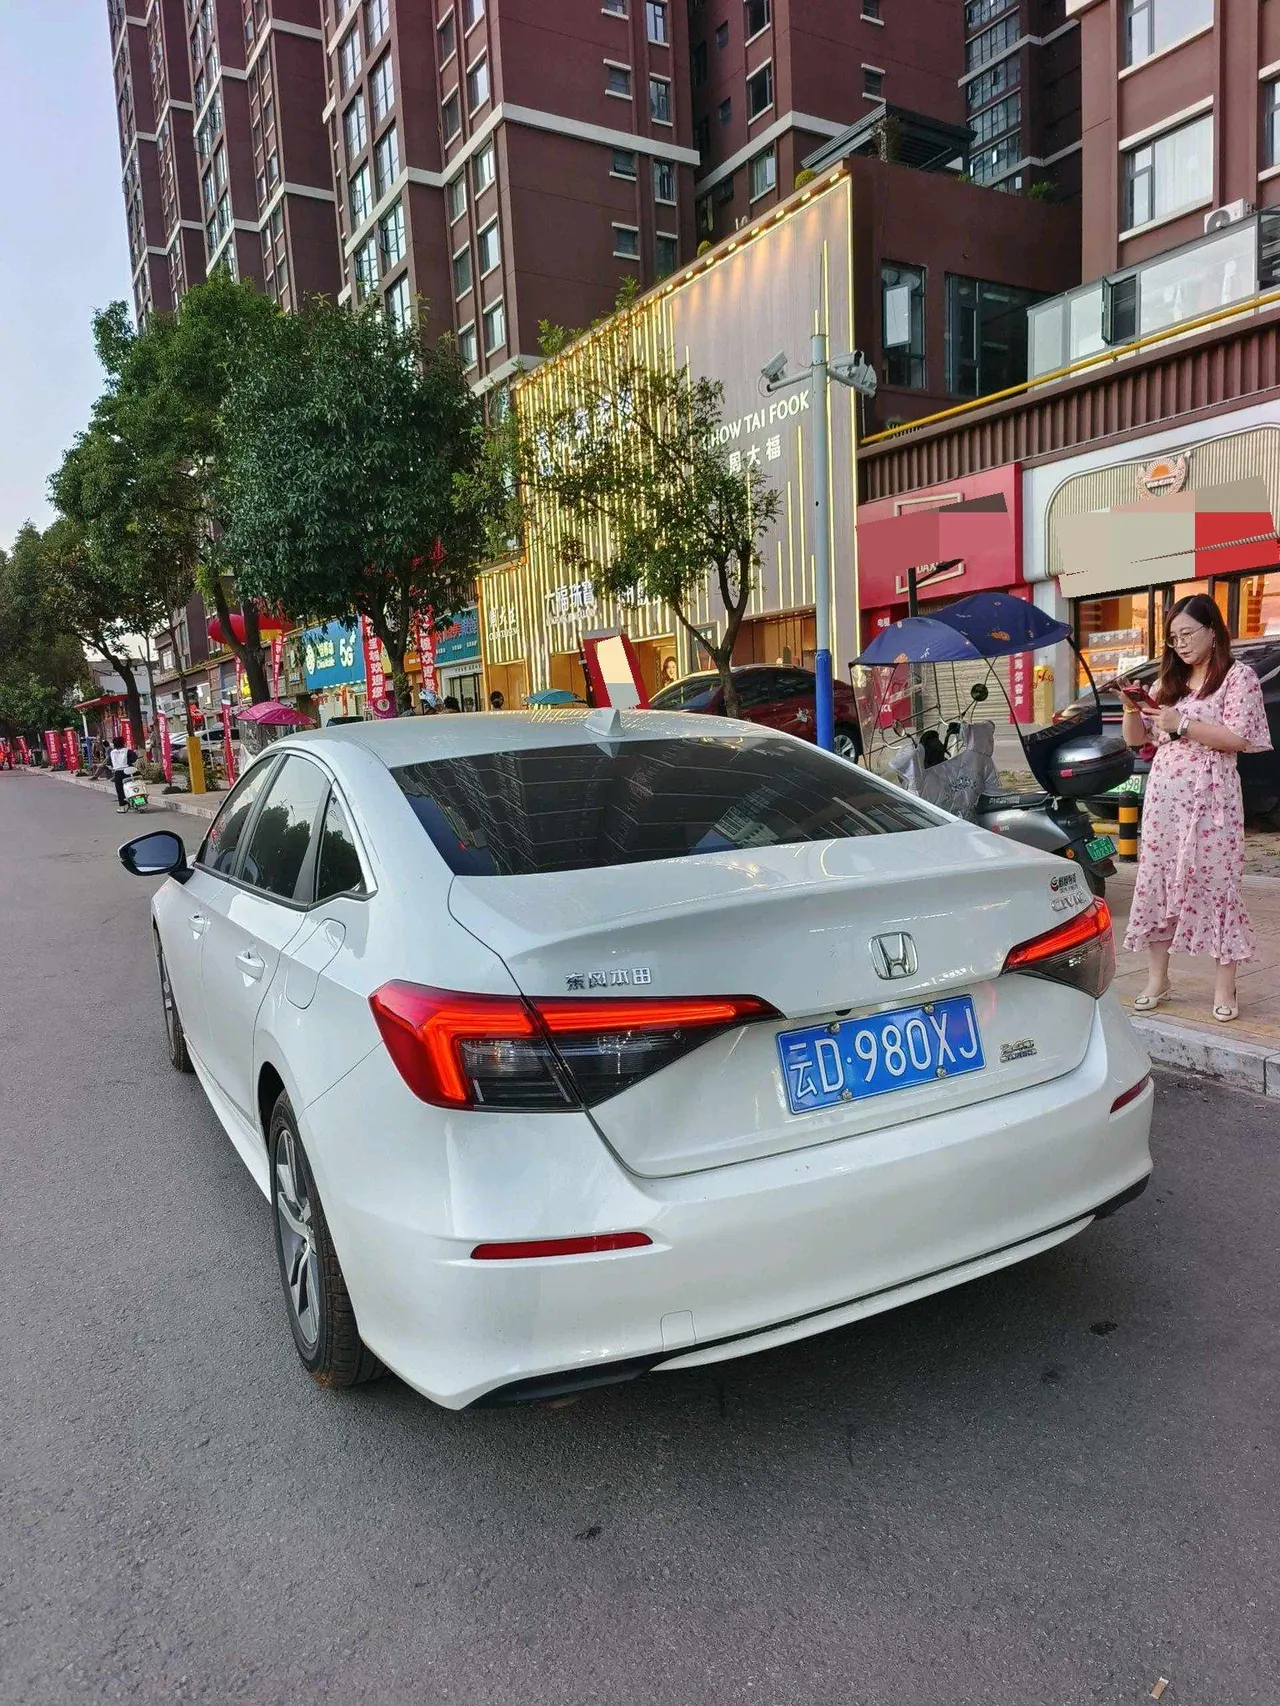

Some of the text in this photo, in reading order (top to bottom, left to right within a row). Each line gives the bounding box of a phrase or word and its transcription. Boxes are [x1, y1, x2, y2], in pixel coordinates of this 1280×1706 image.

[743, 408, 766, 434] TAI
[769, 389, 810, 424] FOOK
[729, 434, 781, 477] 周大福
[339, 637, 354, 668] 5G
[1051, 890, 1087, 912] CIVIC
[565, 967, 652, 991] 东风本田
